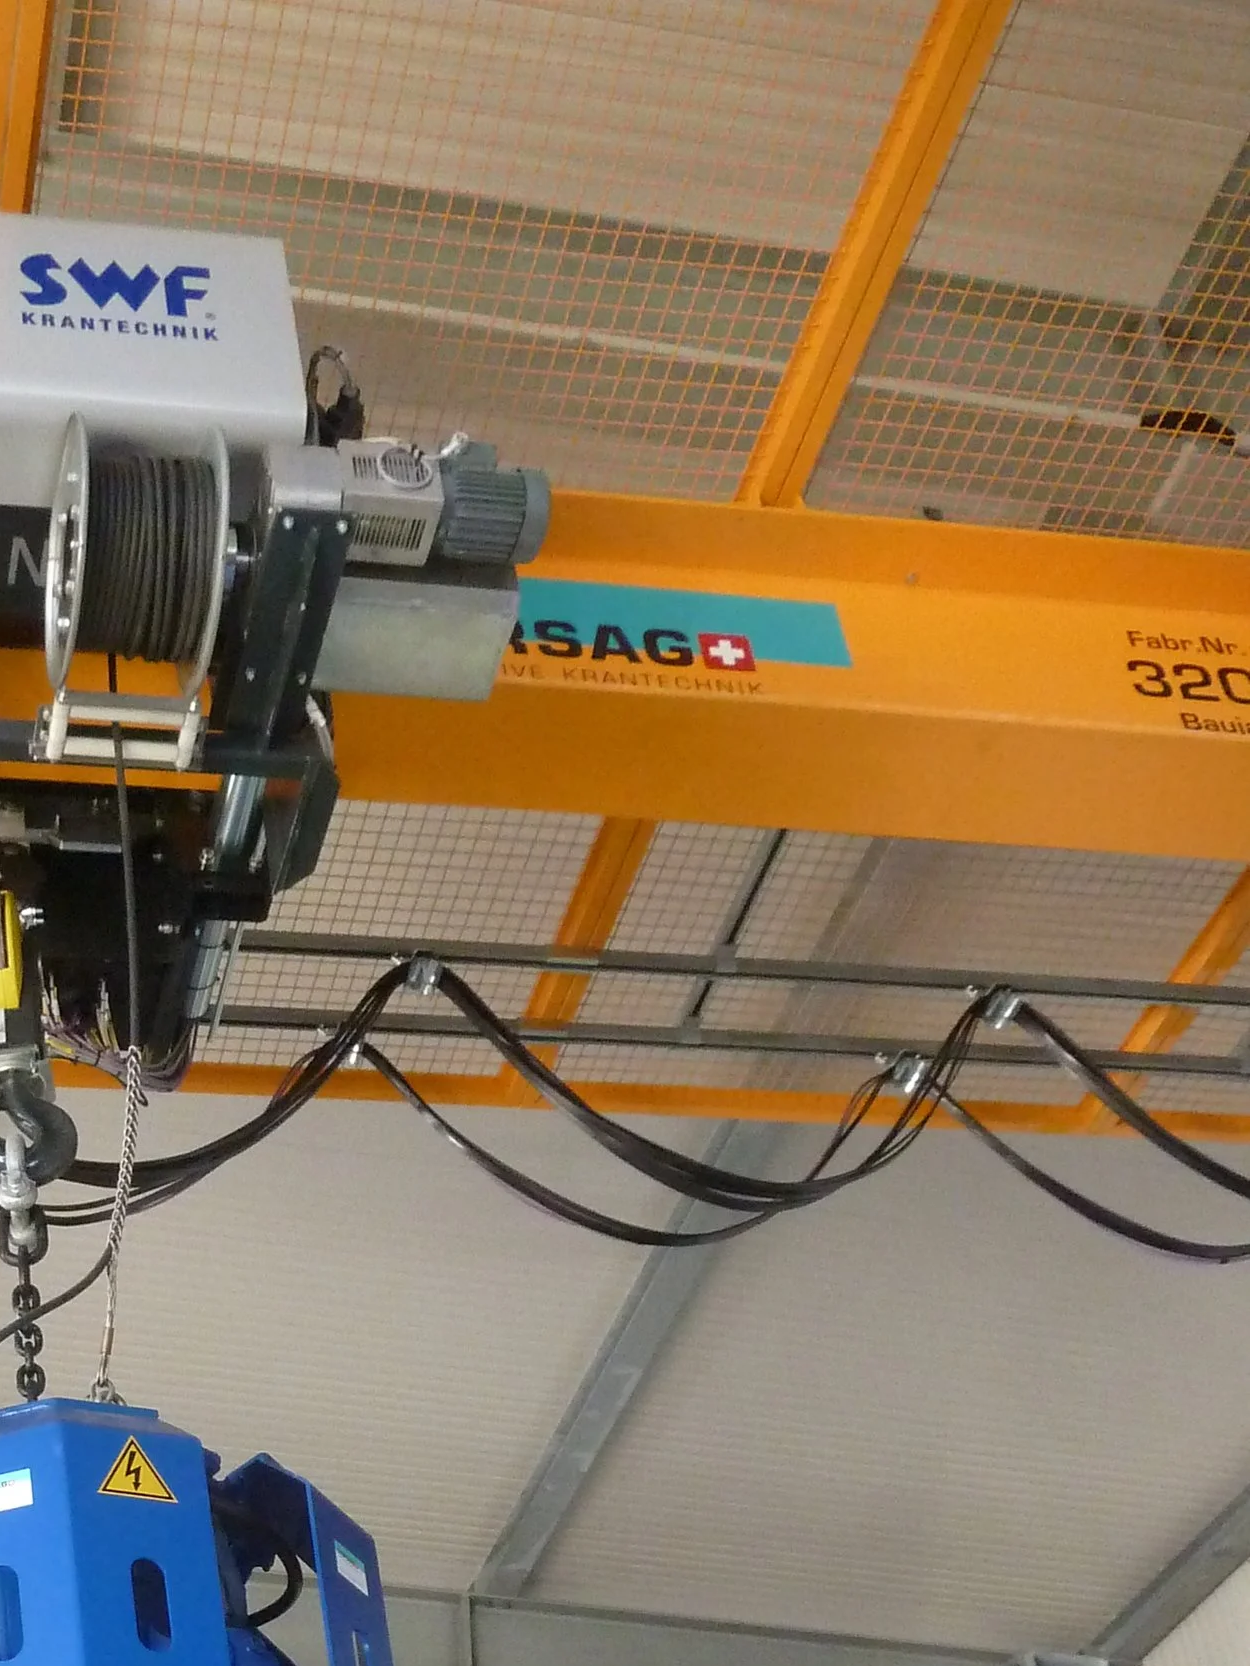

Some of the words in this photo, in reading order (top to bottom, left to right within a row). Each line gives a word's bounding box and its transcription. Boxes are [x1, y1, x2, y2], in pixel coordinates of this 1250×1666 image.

[20, 253, 211, 318] SWF
[21, 311, 219, 341] KRANTECHNIK
[562, 665, 762, 696] KRANTECHNIK
